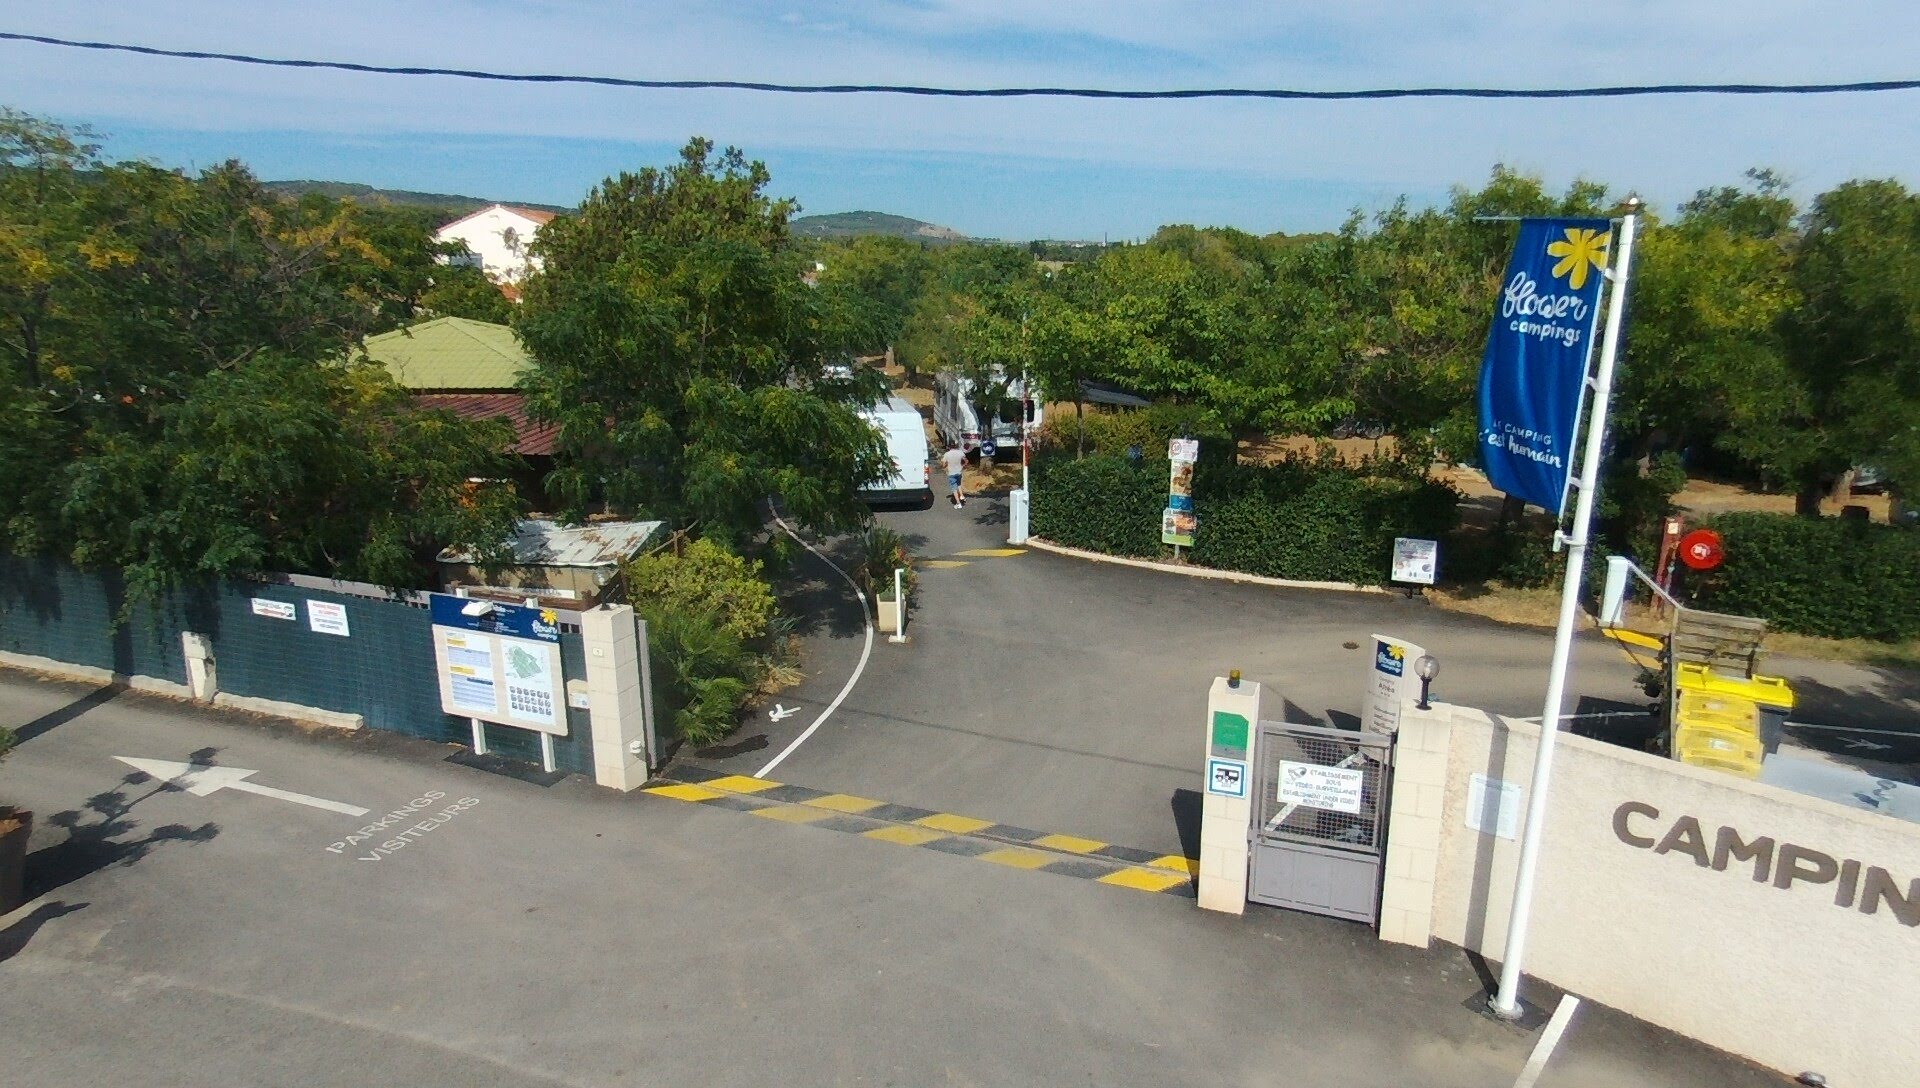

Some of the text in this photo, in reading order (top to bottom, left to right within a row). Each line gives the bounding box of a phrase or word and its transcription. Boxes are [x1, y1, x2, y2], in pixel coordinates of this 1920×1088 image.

[1502, 271, 1588, 321] flower
[1510, 320, 1581, 347] campings
[1508, 434, 1562, 469] humain
[325, 790, 446, 854] PARKINGS
[357, 797, 480, 862] VISITEURS
